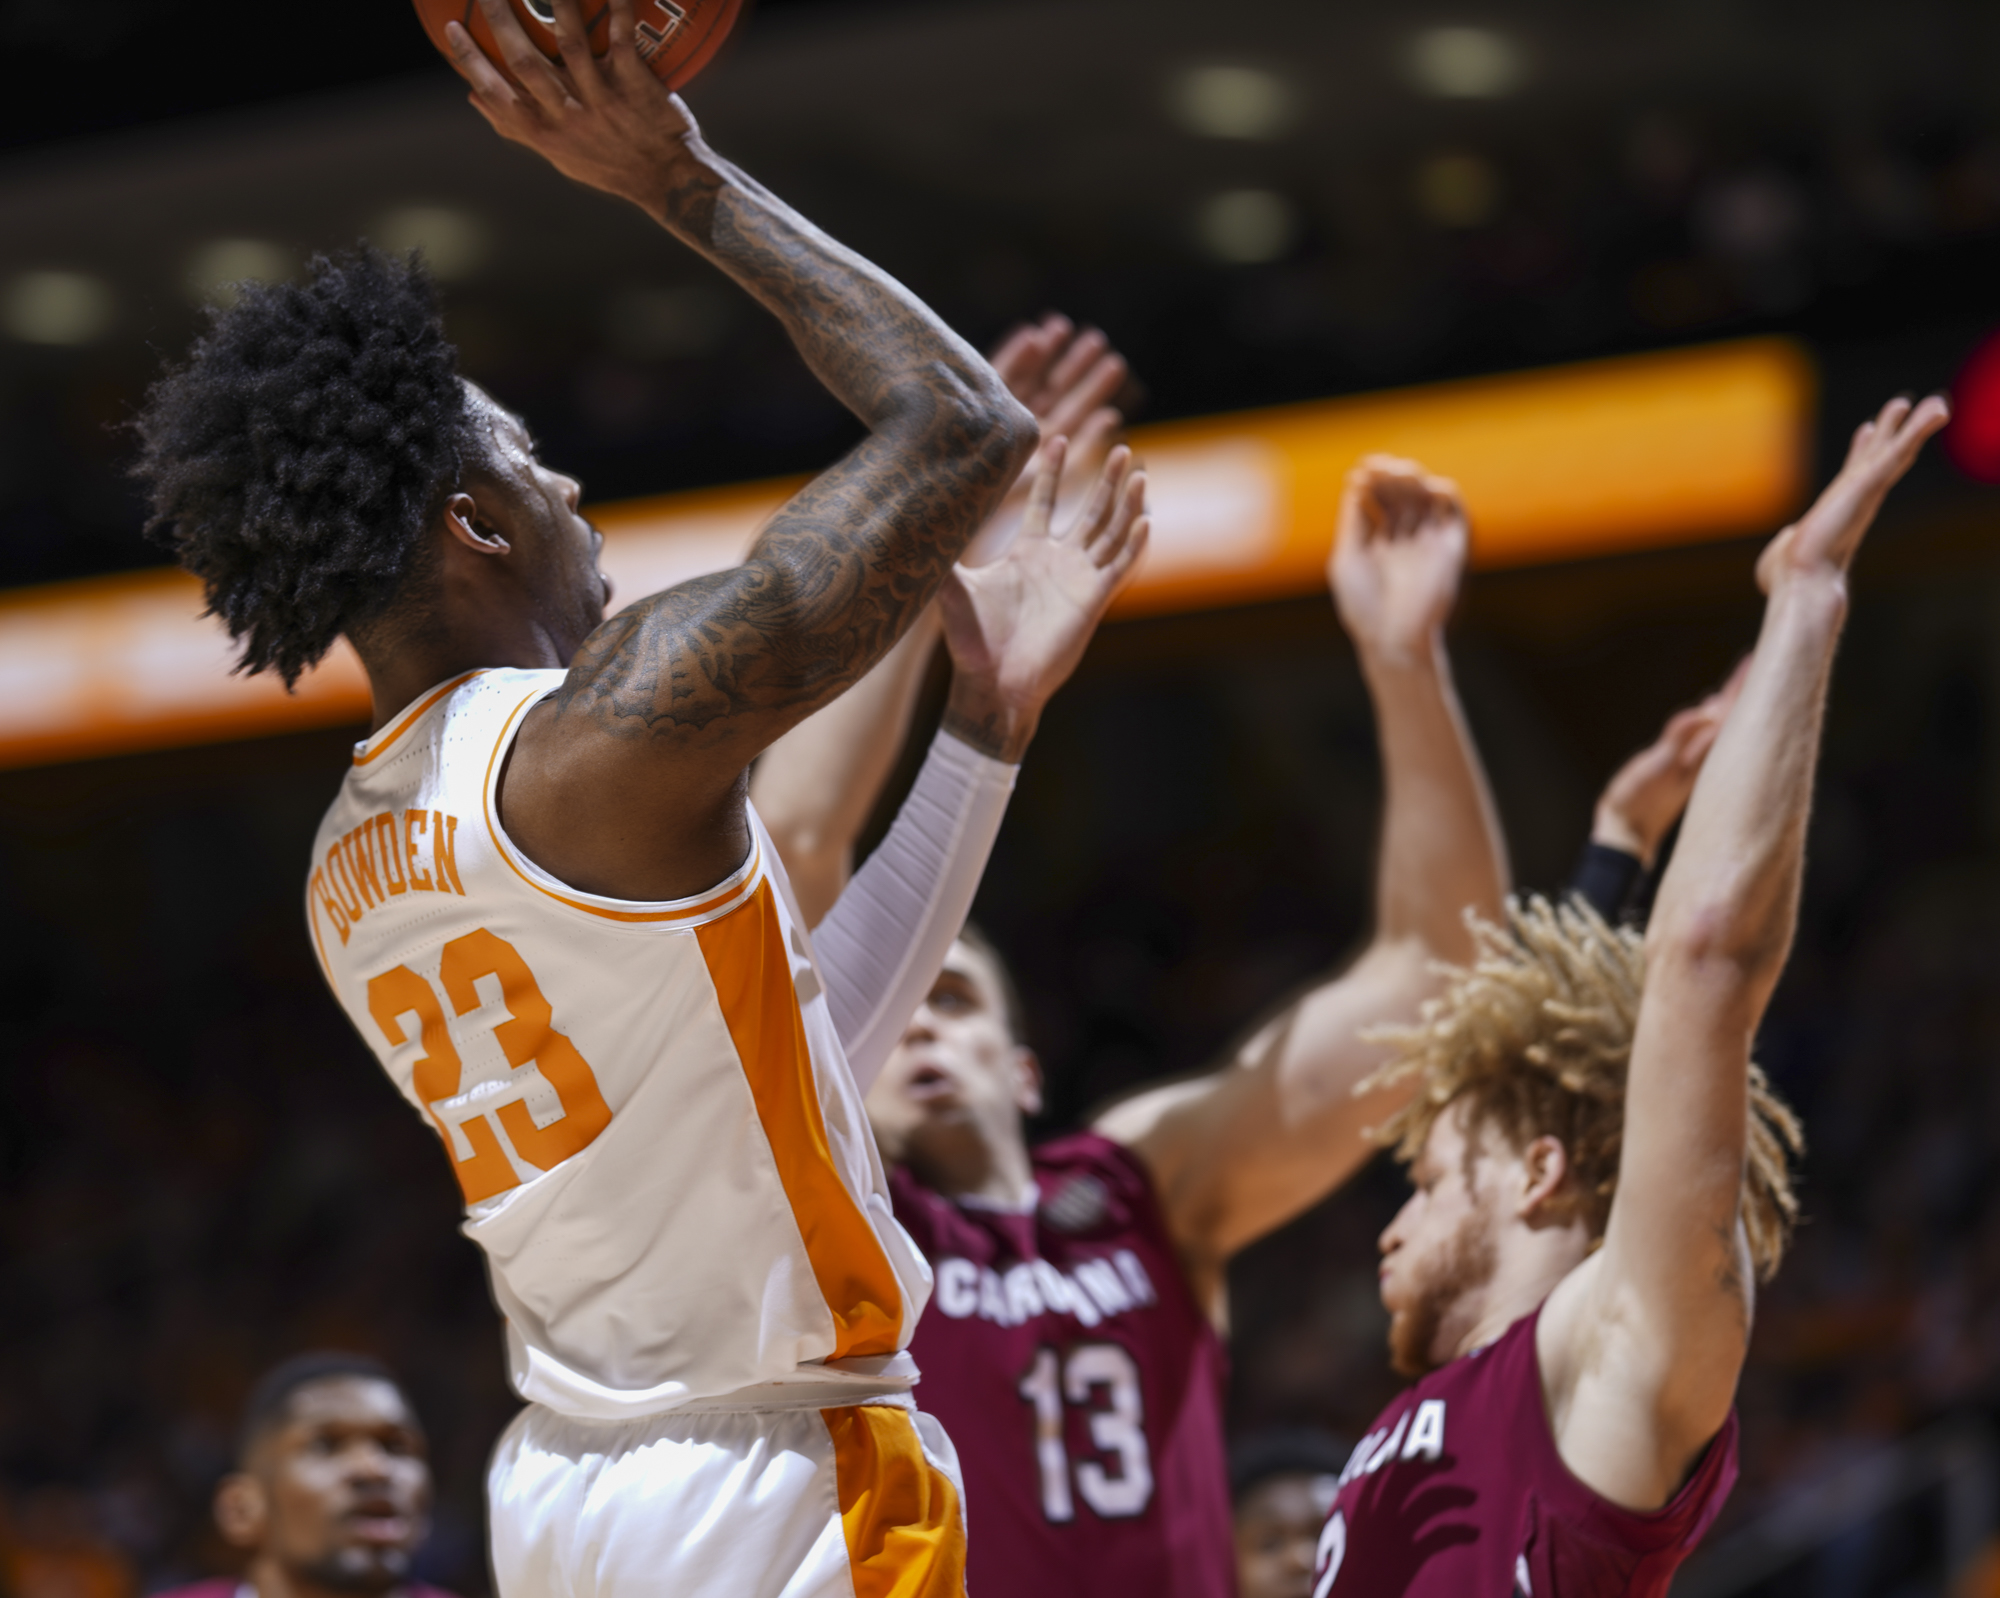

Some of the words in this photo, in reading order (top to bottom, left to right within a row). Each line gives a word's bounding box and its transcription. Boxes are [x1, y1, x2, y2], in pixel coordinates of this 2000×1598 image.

[311, 808, 467, 948] BOWDEN
[367, 927, 613, 1206] 23
[1019, 1341, 1155, 1522] 13
